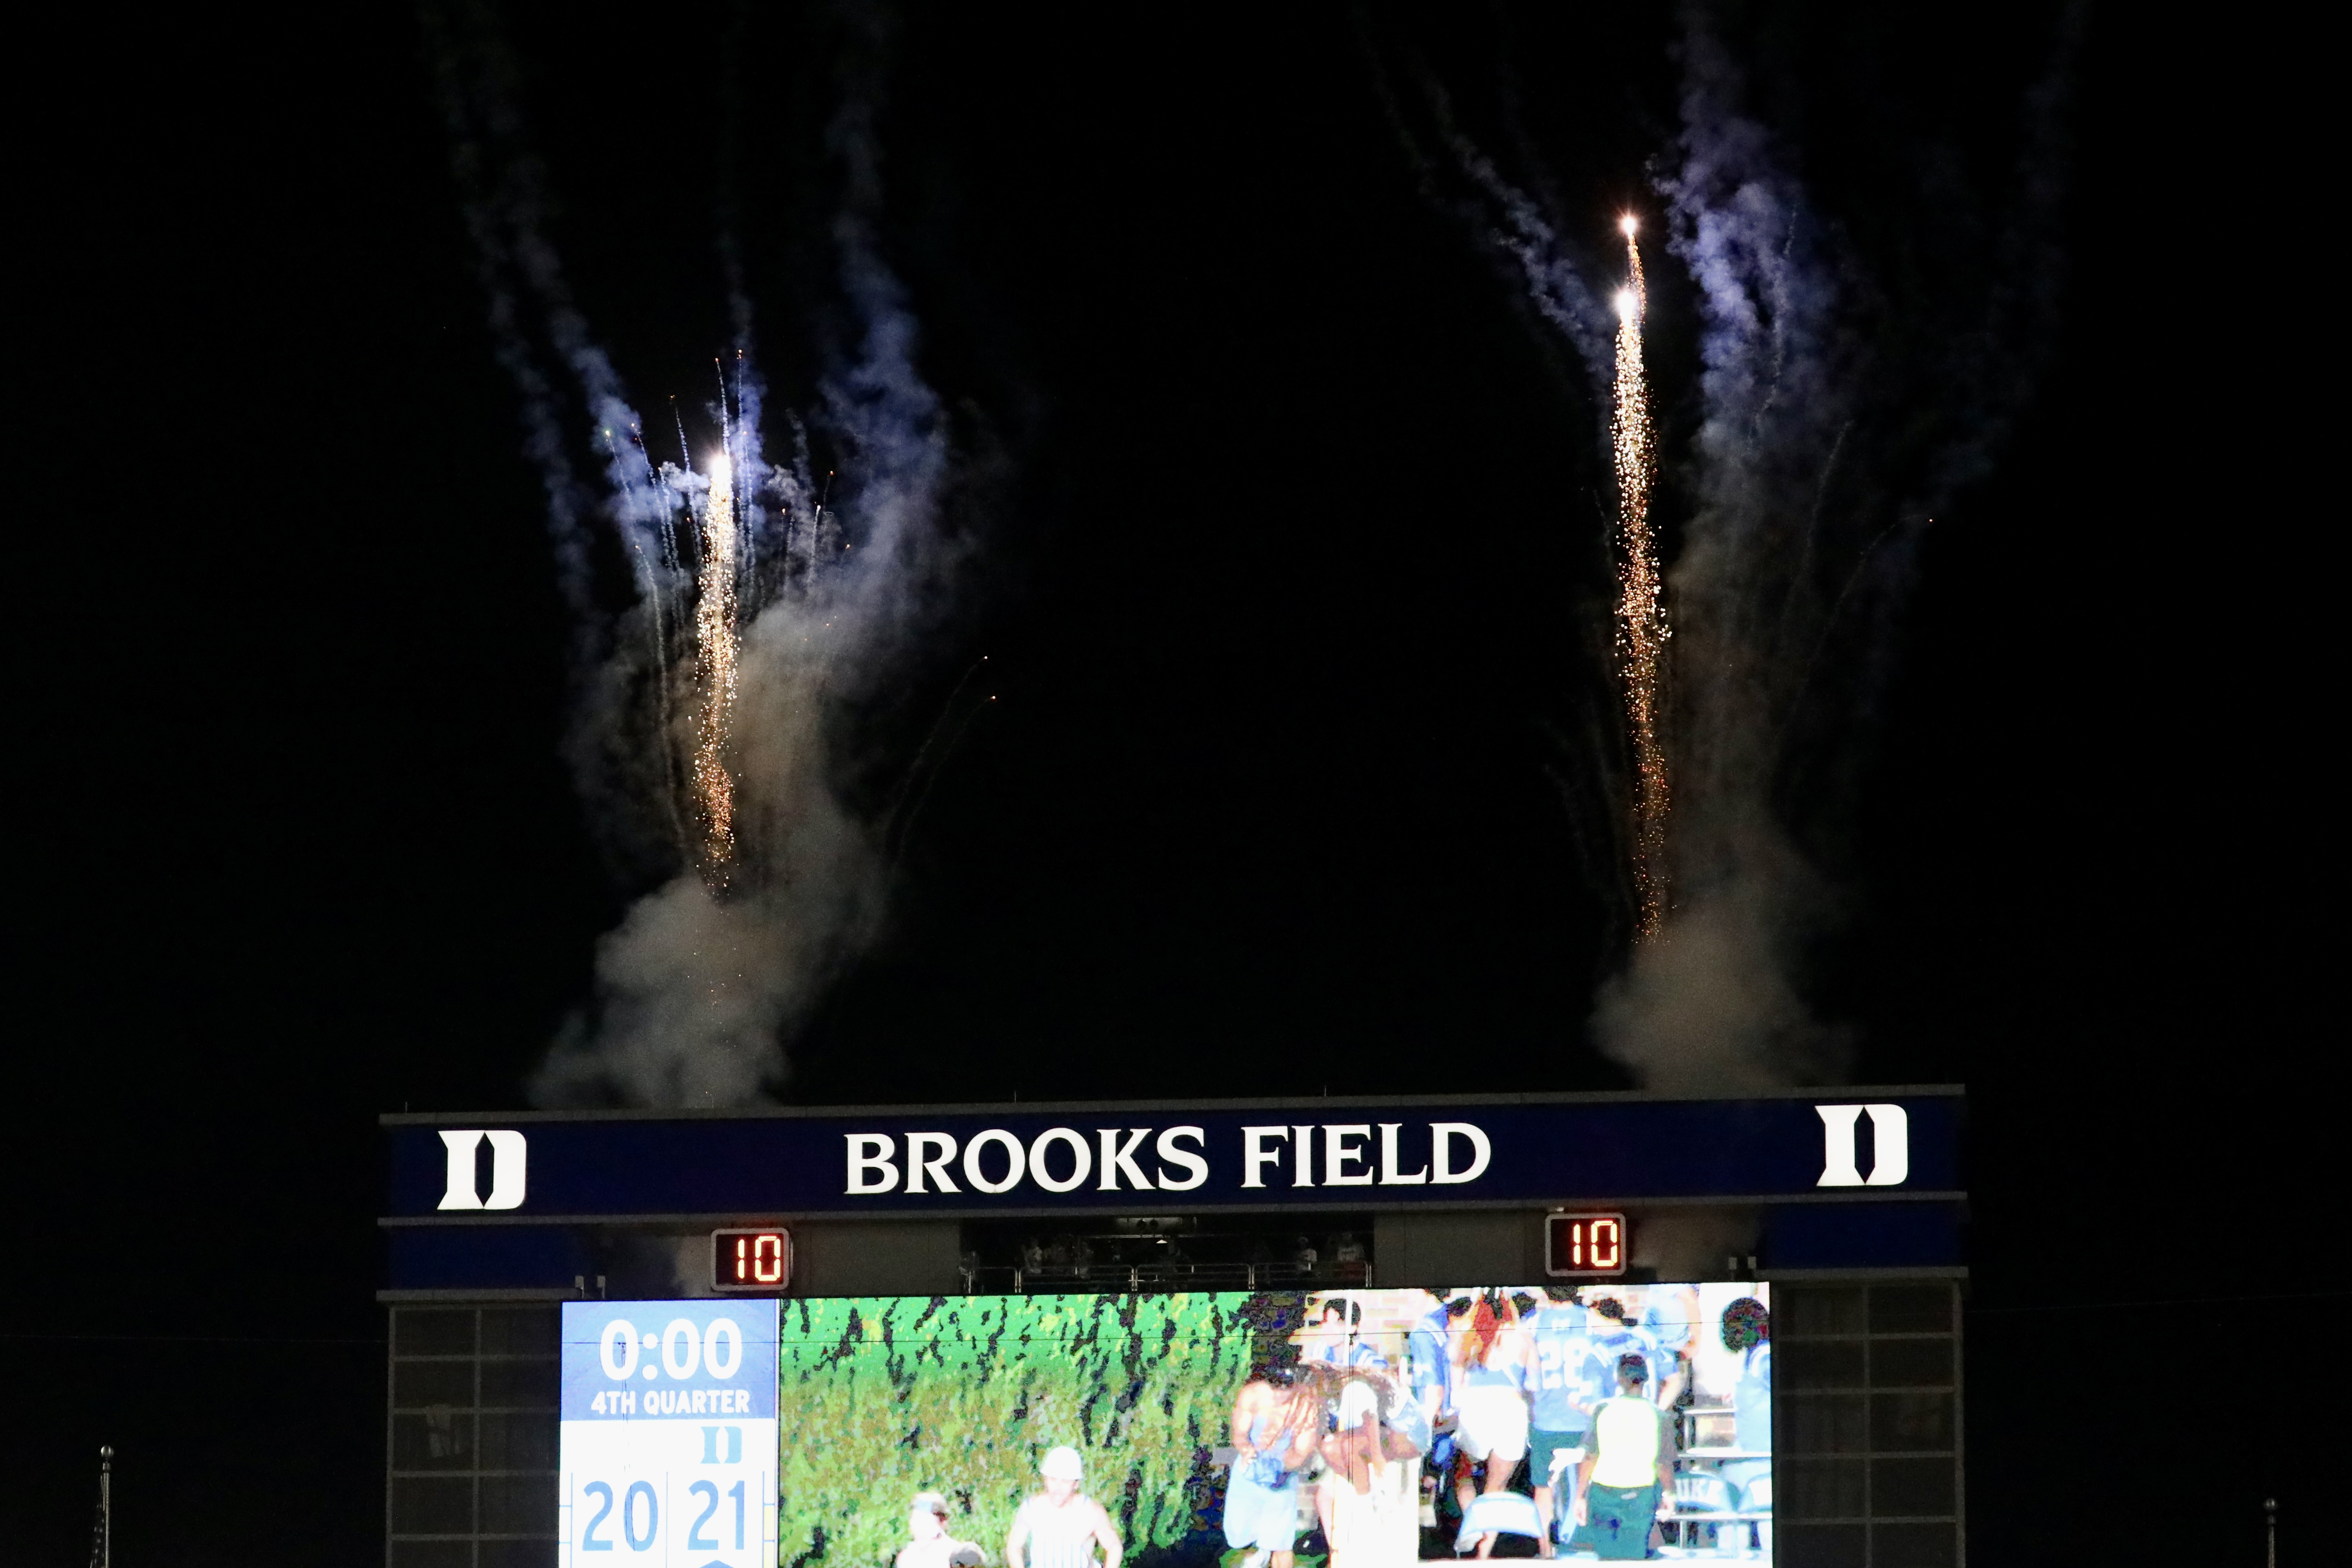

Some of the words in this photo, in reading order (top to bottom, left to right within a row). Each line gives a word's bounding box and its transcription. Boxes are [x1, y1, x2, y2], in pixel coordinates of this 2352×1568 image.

[437, 1130, 527, 1210] D
[844, 1126, 1209, 1194] BROOKS
[1241, 1122, 1491, 1188] FIELD
[1815, 1104, 1908, 1187] D
[737, 1235, 781, 1282] 10
[1572, 1220, 1618, 1267] 10
[599, 1317, 743, 1381] 0:00
[591, 1391, 636, 1415] 4TH
[643, 1389, 750, 1416] QUARTER
[700, 1426, 743, 1464] D
[582, 1480, 659, 1552] 20
[687, 1479, 745, 1550] 21
